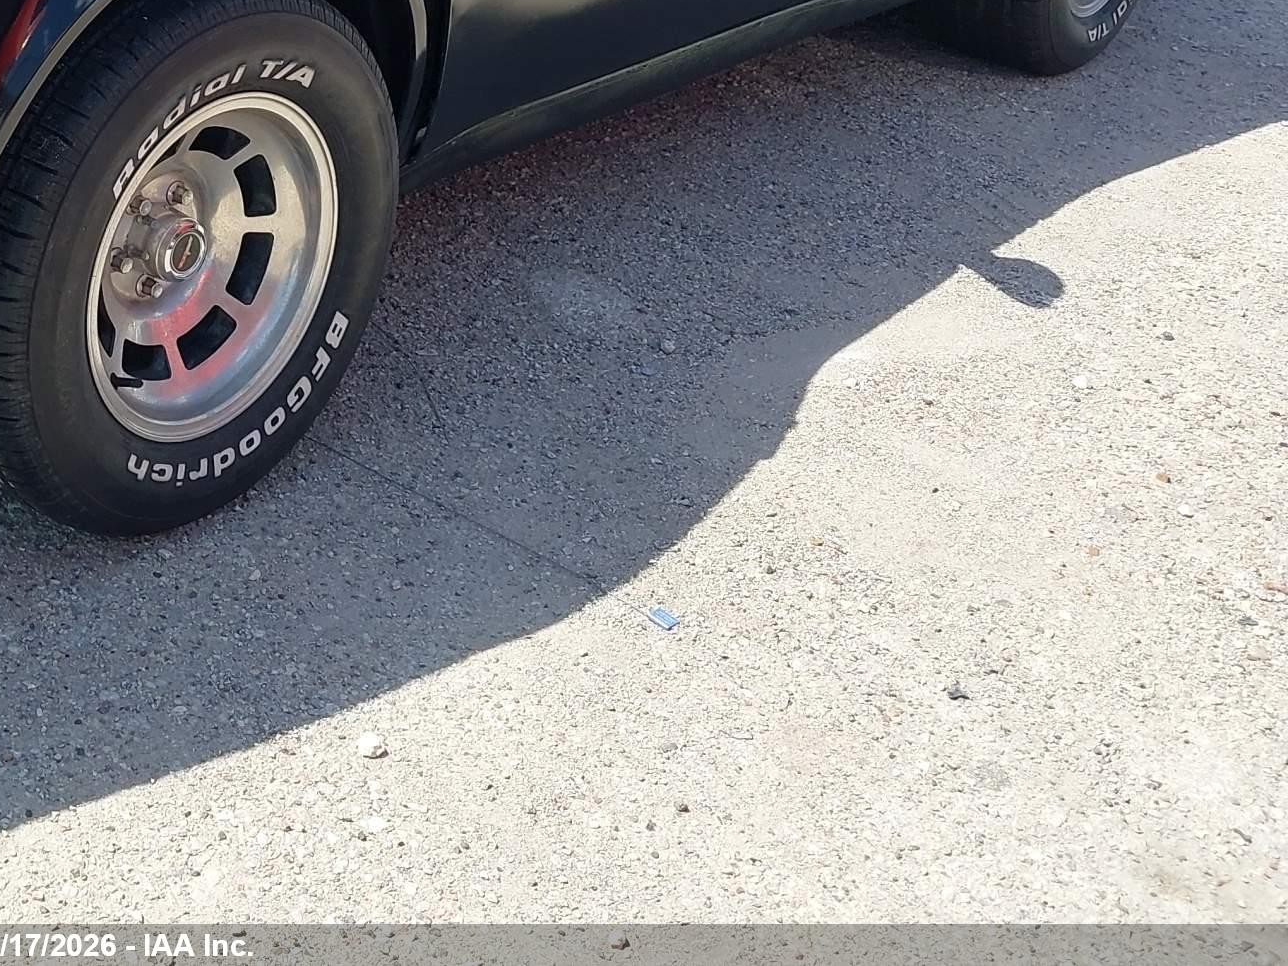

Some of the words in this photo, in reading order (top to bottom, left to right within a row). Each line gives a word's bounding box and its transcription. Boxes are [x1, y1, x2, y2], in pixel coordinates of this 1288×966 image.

[1087, 22, 1110, 42] T/A
[112, 64, 247, 200] Radial
[260, 60, 316, 88] T/A
[127, 310, 350, 487] BFGoodrich
